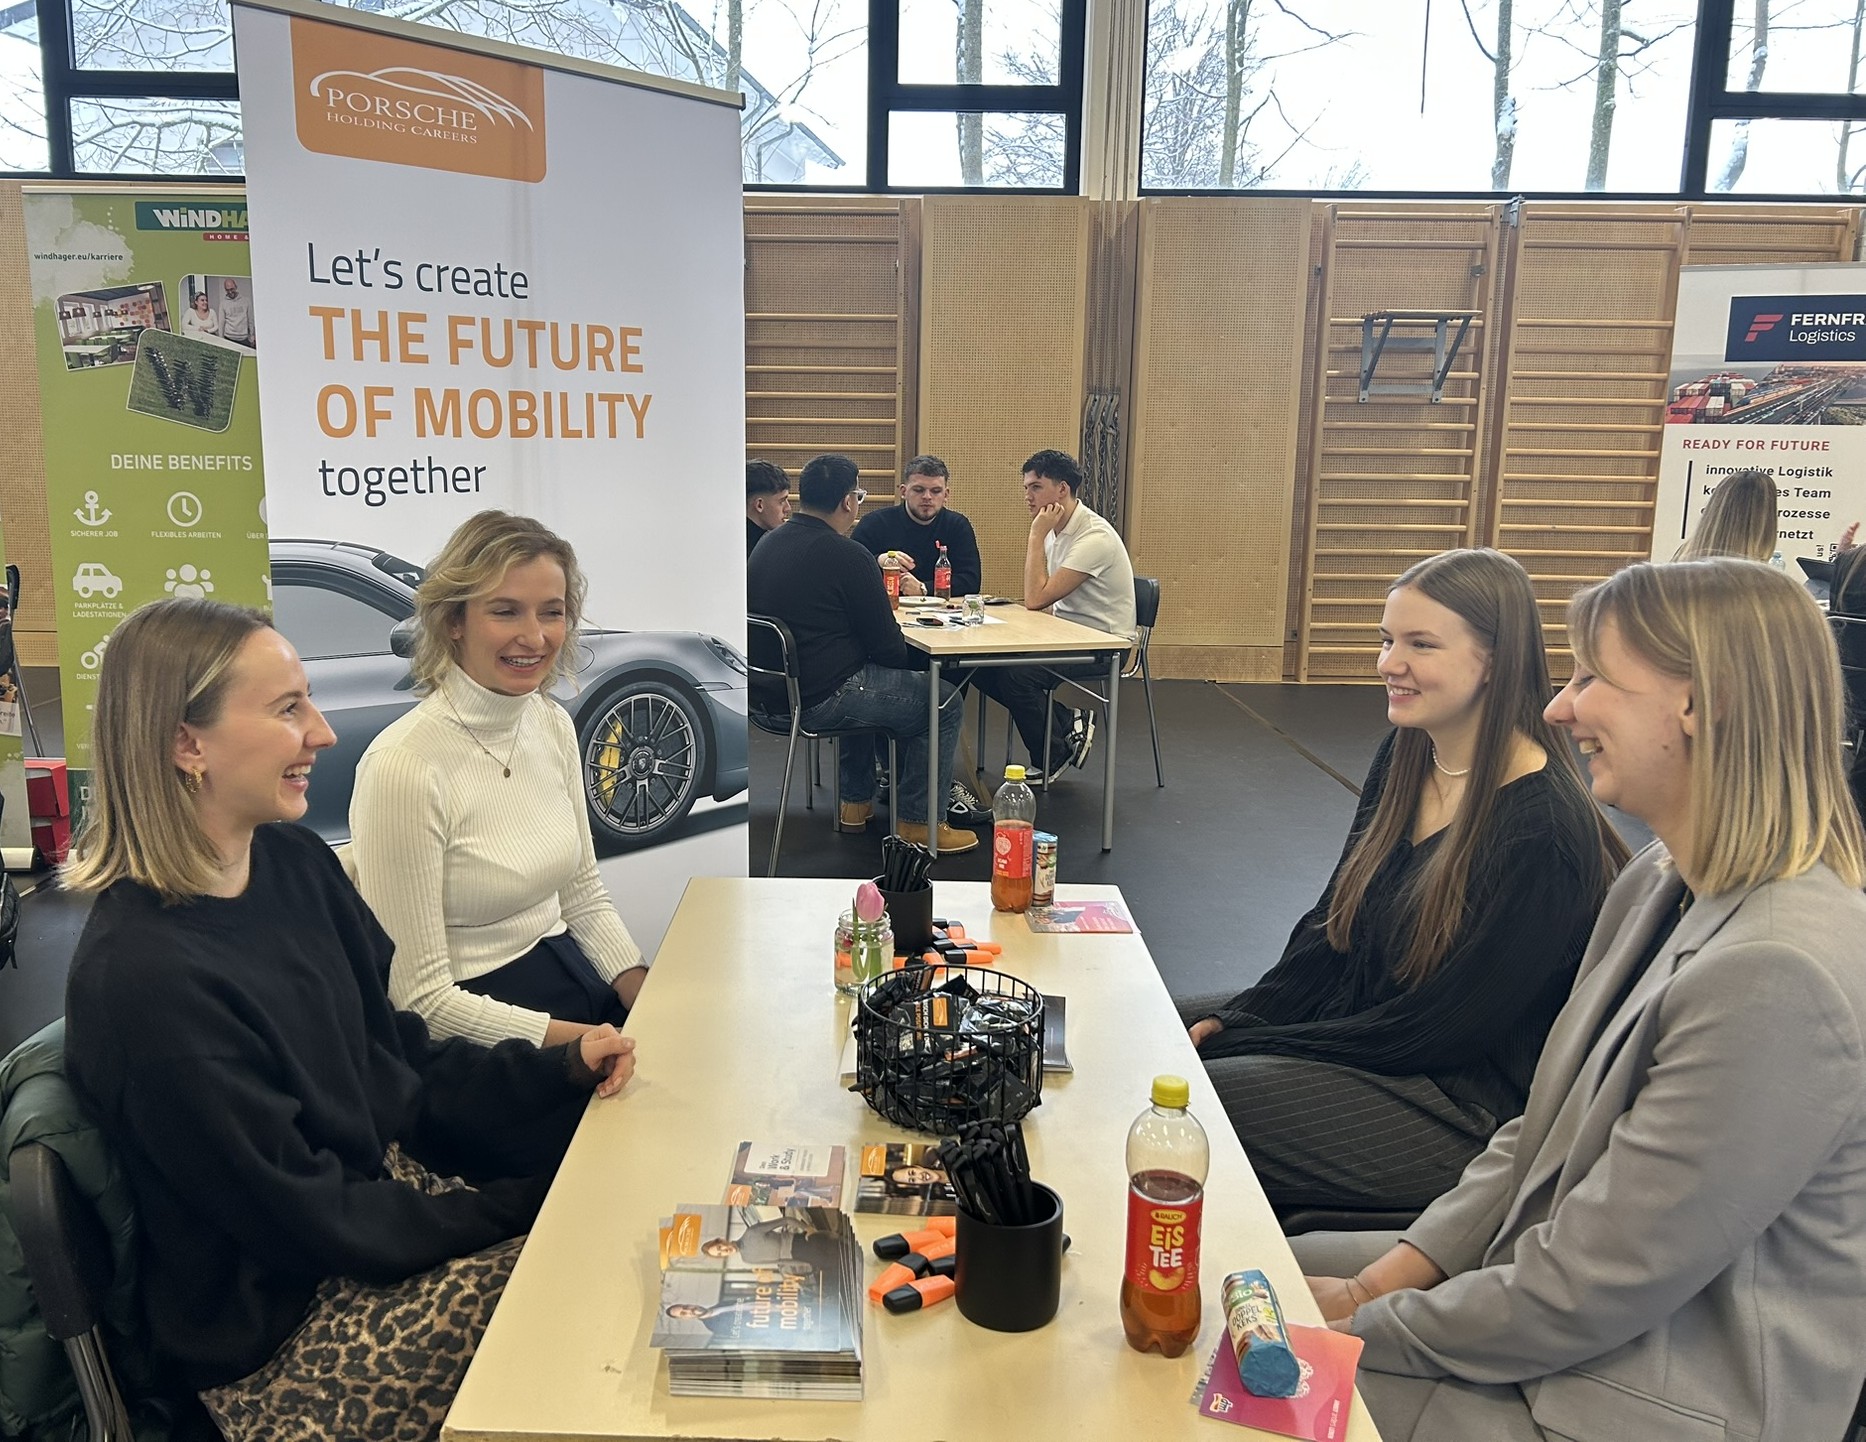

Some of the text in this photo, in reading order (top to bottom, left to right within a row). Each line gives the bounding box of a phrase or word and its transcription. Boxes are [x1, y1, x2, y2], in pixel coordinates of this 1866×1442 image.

[326, 87, 477, 131] PORSCHE
[327, 112, 477, 144] HOLDING CAREERS
[34, 252, 123, 261] windhager.eu/karriere
[308, 242, 529, 299] Let's create
[1791, 313, 1866, 326] FERNFR
[308, 305, 645, 373] THE FUTURE
[1789, 328, 1856, 345] Logistics
[316, 384, 653, 439] OF MOBILITY
[1682, 439, 1830, 452] READY FOR FUTURE
[111, 454, 253, 471] DEINE BENEFITS
[1778, 466, 1833, 479] Logistik
[318, 456, 487, 508] together
[1794, 487, 1831, 499] Team
[1777, 509, 1830, 519] rozesse
[188, 531, 222, 539] ARBEITEN
[1149, 1245, 1183, 1268] TEE
[746, 1286, 772, 1329] future
[776, 1274, 805, 1330] mobility
